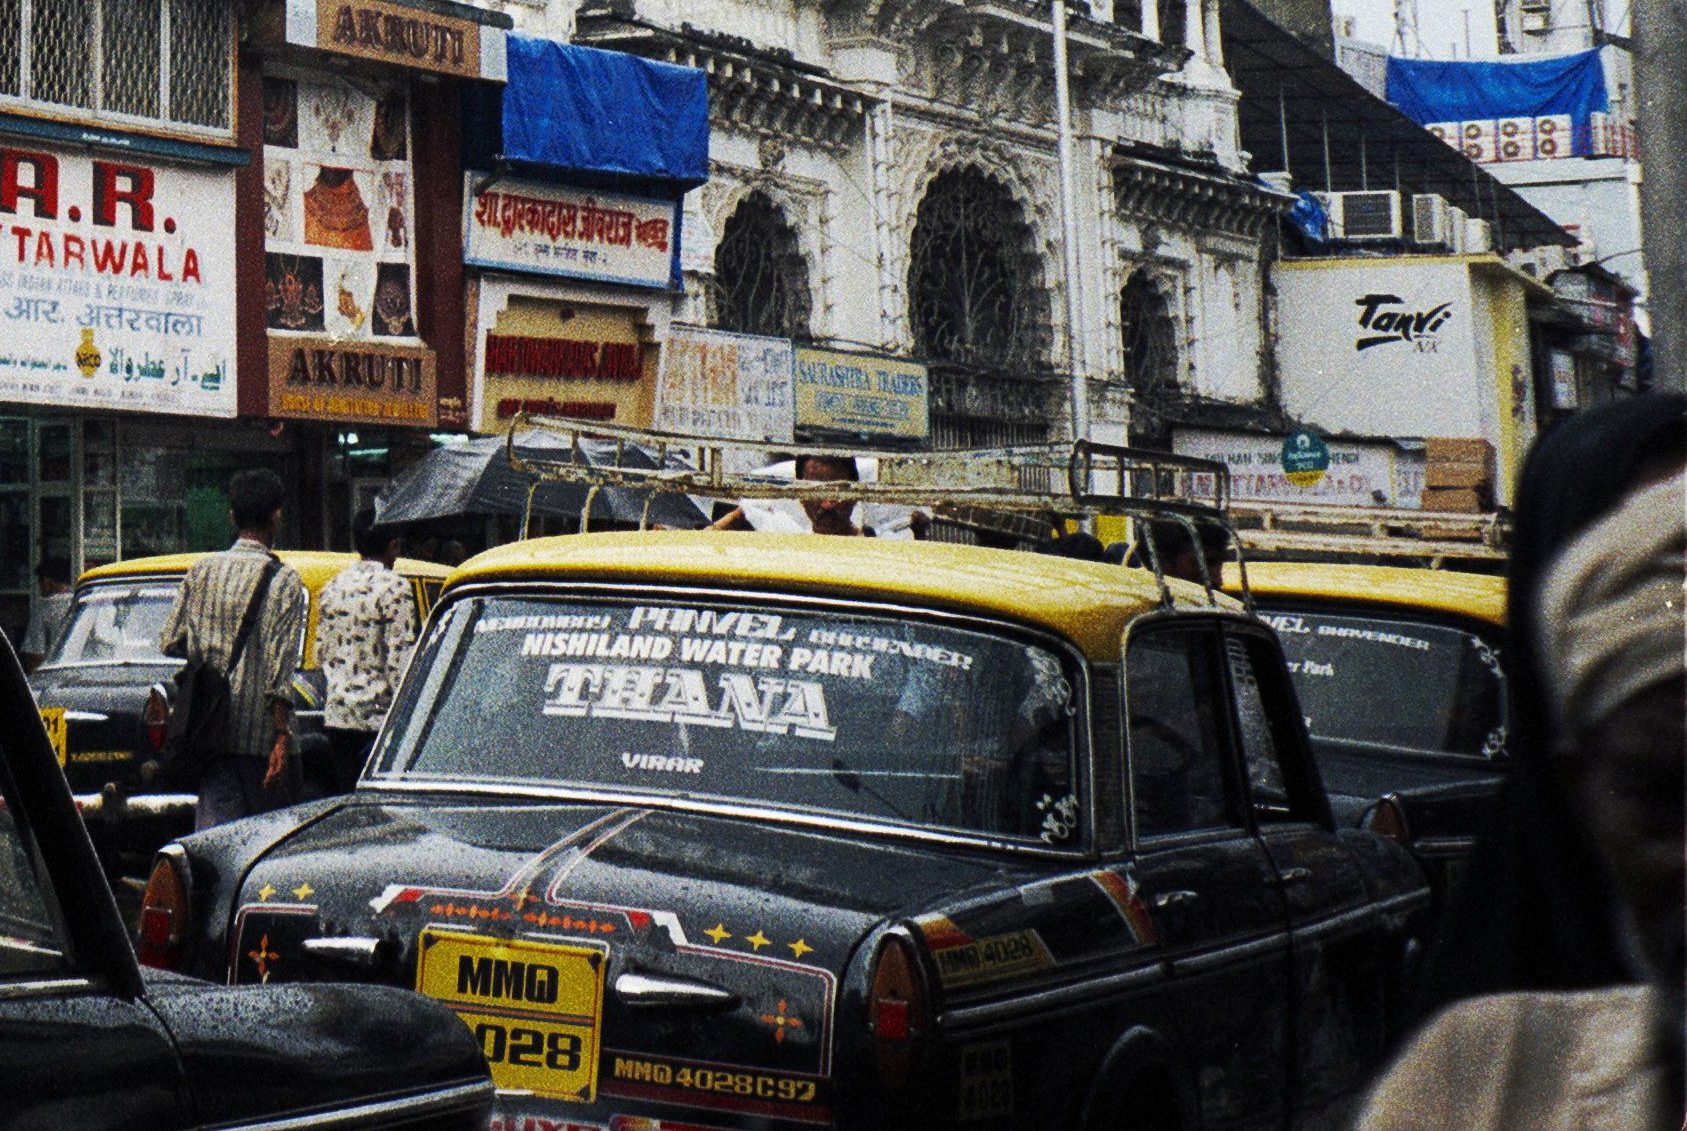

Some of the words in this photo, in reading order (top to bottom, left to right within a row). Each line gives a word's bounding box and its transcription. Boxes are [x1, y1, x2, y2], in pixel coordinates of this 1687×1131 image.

[333, 3, 464, 67] AKRUTI
[1355, 294, 1453, 342] Tanvi
[287, 347, 424, 394] AKRUTI
[627, 606, 797, 641] PANVEL
[520, 633, 673, 659] NISHILAND
[680, 637, 783, 669] WATER
[789, 647, 876, 679] PARK
[542, 663, 838, 741] THANA
[621, 752, 705, 774] VIRAR
[457, 954, 559, 1005] MMQ
[475, 1023, 583, 1072] 028
